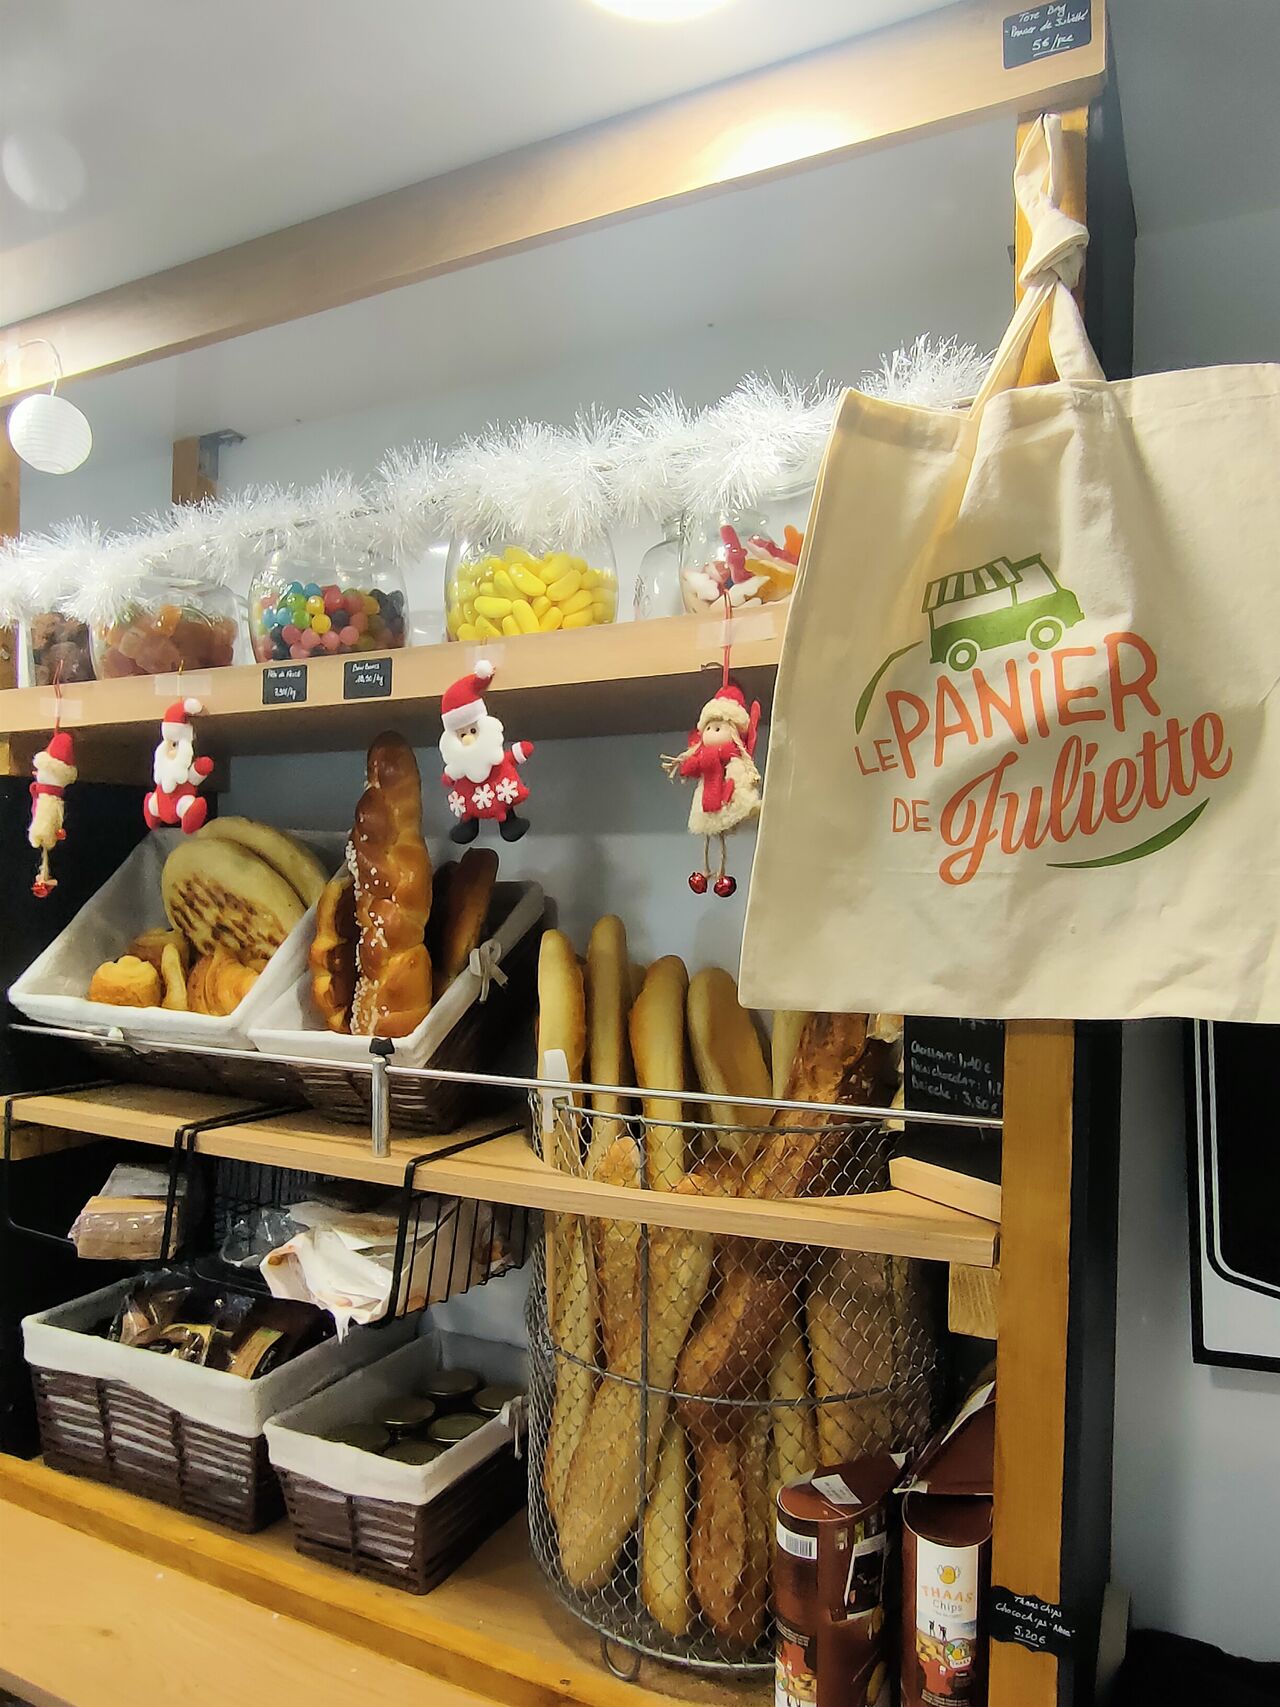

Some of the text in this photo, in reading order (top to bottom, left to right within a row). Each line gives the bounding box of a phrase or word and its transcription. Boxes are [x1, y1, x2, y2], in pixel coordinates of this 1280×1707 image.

[854, 738, 898, 776] LE
[892, 711, 1232, 885] DE Juliette
[920, 1584, 975, 1604] THAAS
[932, 1599, 963, 1614] Chips
